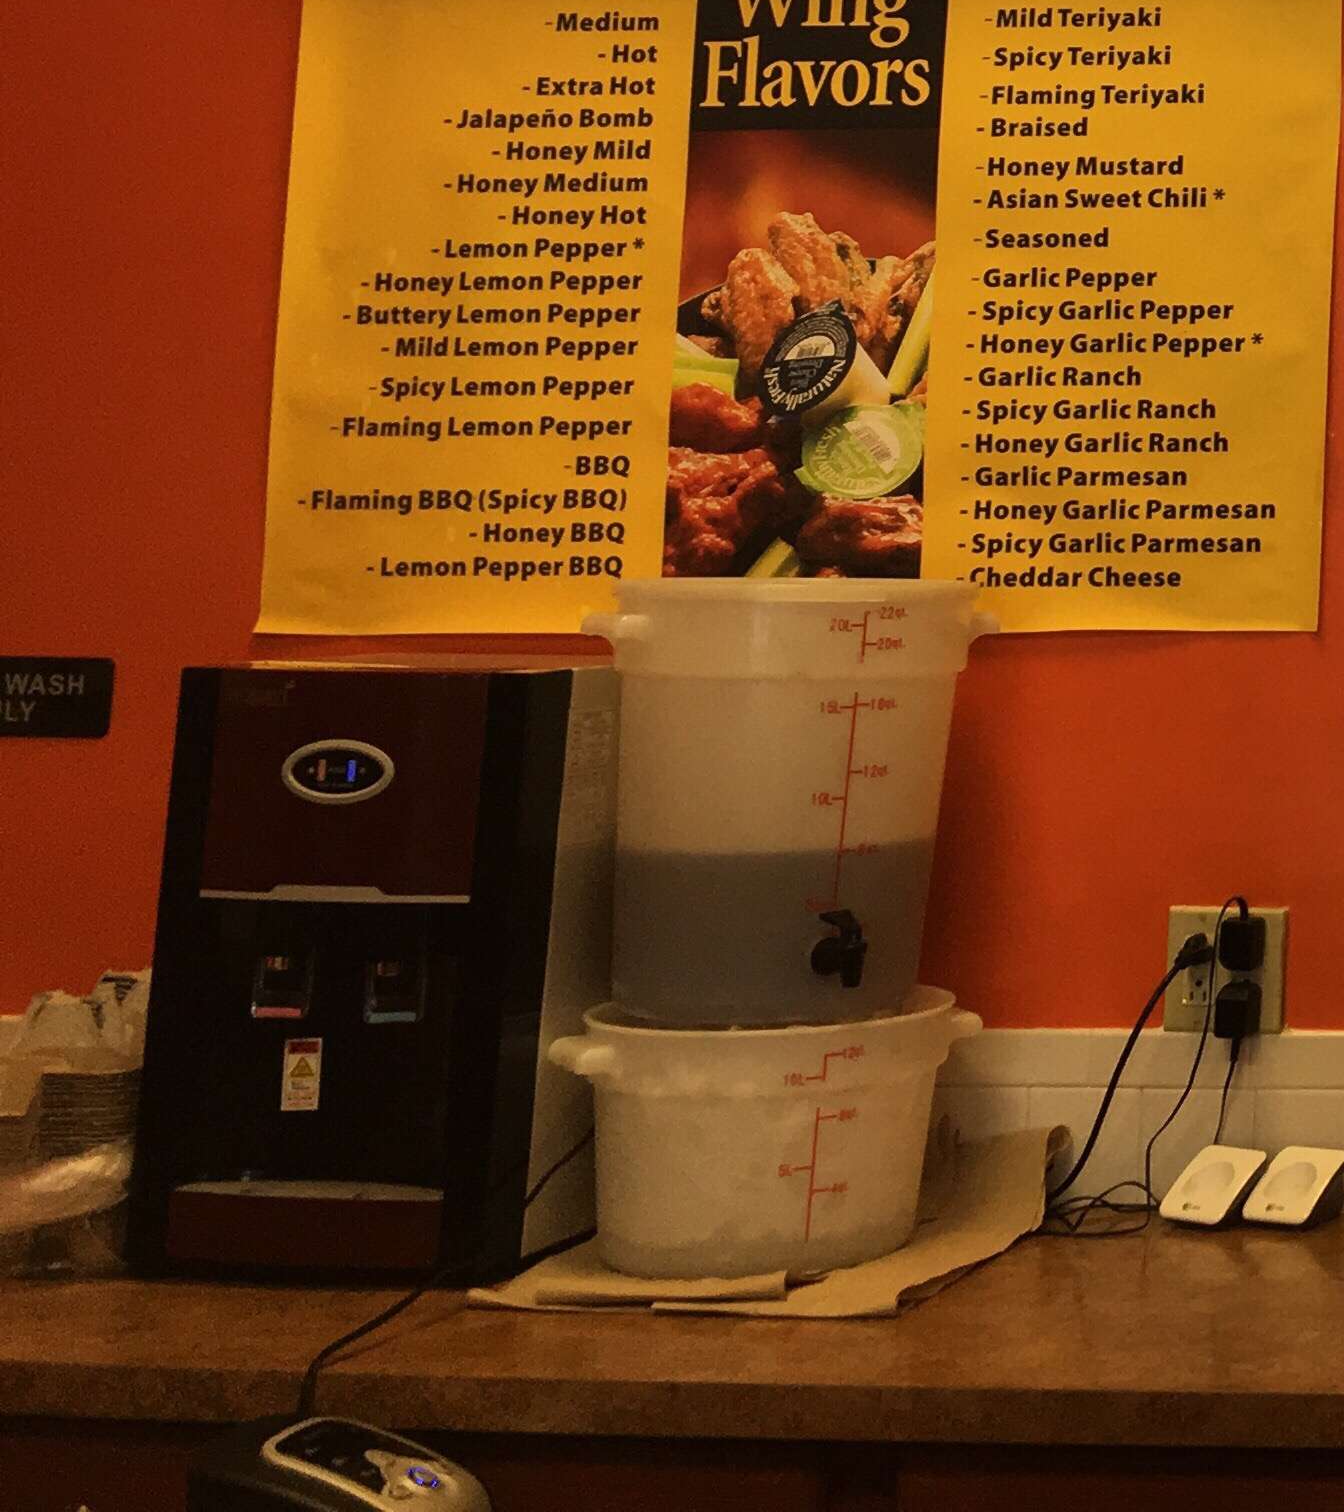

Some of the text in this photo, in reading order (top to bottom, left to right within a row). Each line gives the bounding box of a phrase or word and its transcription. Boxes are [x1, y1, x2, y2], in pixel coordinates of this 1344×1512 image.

[612, 45, 657, 63] Hot
[699, 38, 931, 108] Flavors
[537, 77, 655, 96] Extra Hot
[456, 107, 653, 133] Jalapeño Bomb
[991, 117, 1088, 137] Braised
[357, 304, 640, 329] Buttery Lemon Pepper
[983, 299, 1233, 325] Spicy Garlic Pepper
[975, 466, 1187, 486] Garlic Parmesan
[484, 522, 624, 547] Honey BBQ
[4, 672, 86, 696] WASH
